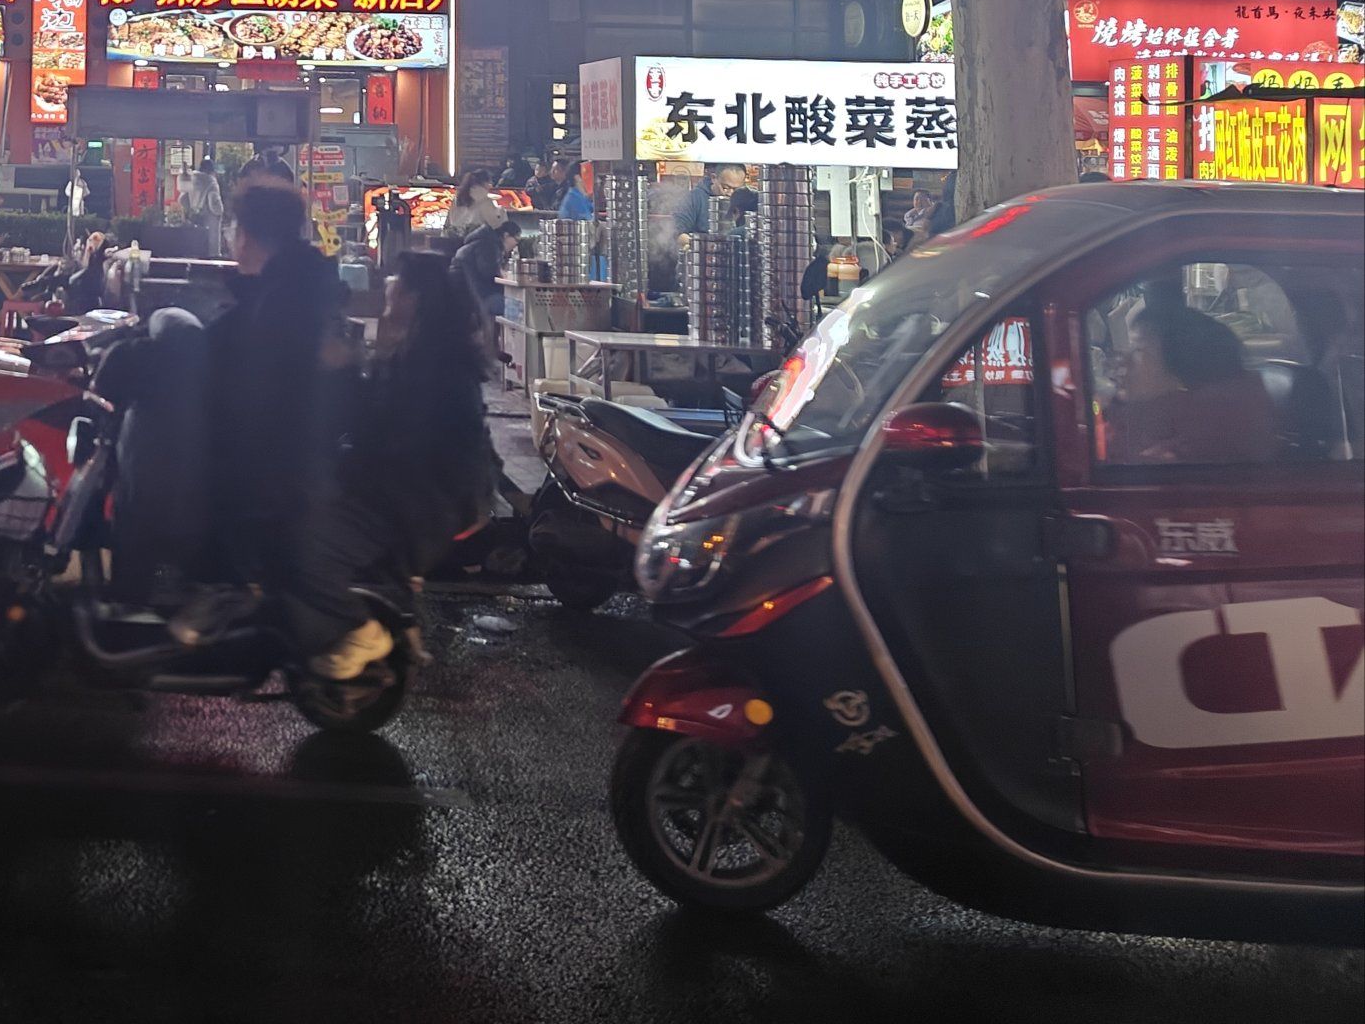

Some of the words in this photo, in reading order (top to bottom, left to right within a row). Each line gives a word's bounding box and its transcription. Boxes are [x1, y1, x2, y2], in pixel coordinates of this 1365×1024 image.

[1165, 63, 1178, 115] 排骨面
[665, 92, 958, 149] 东北酸菜蒸
[1319, 104, 1365, 184] 网
